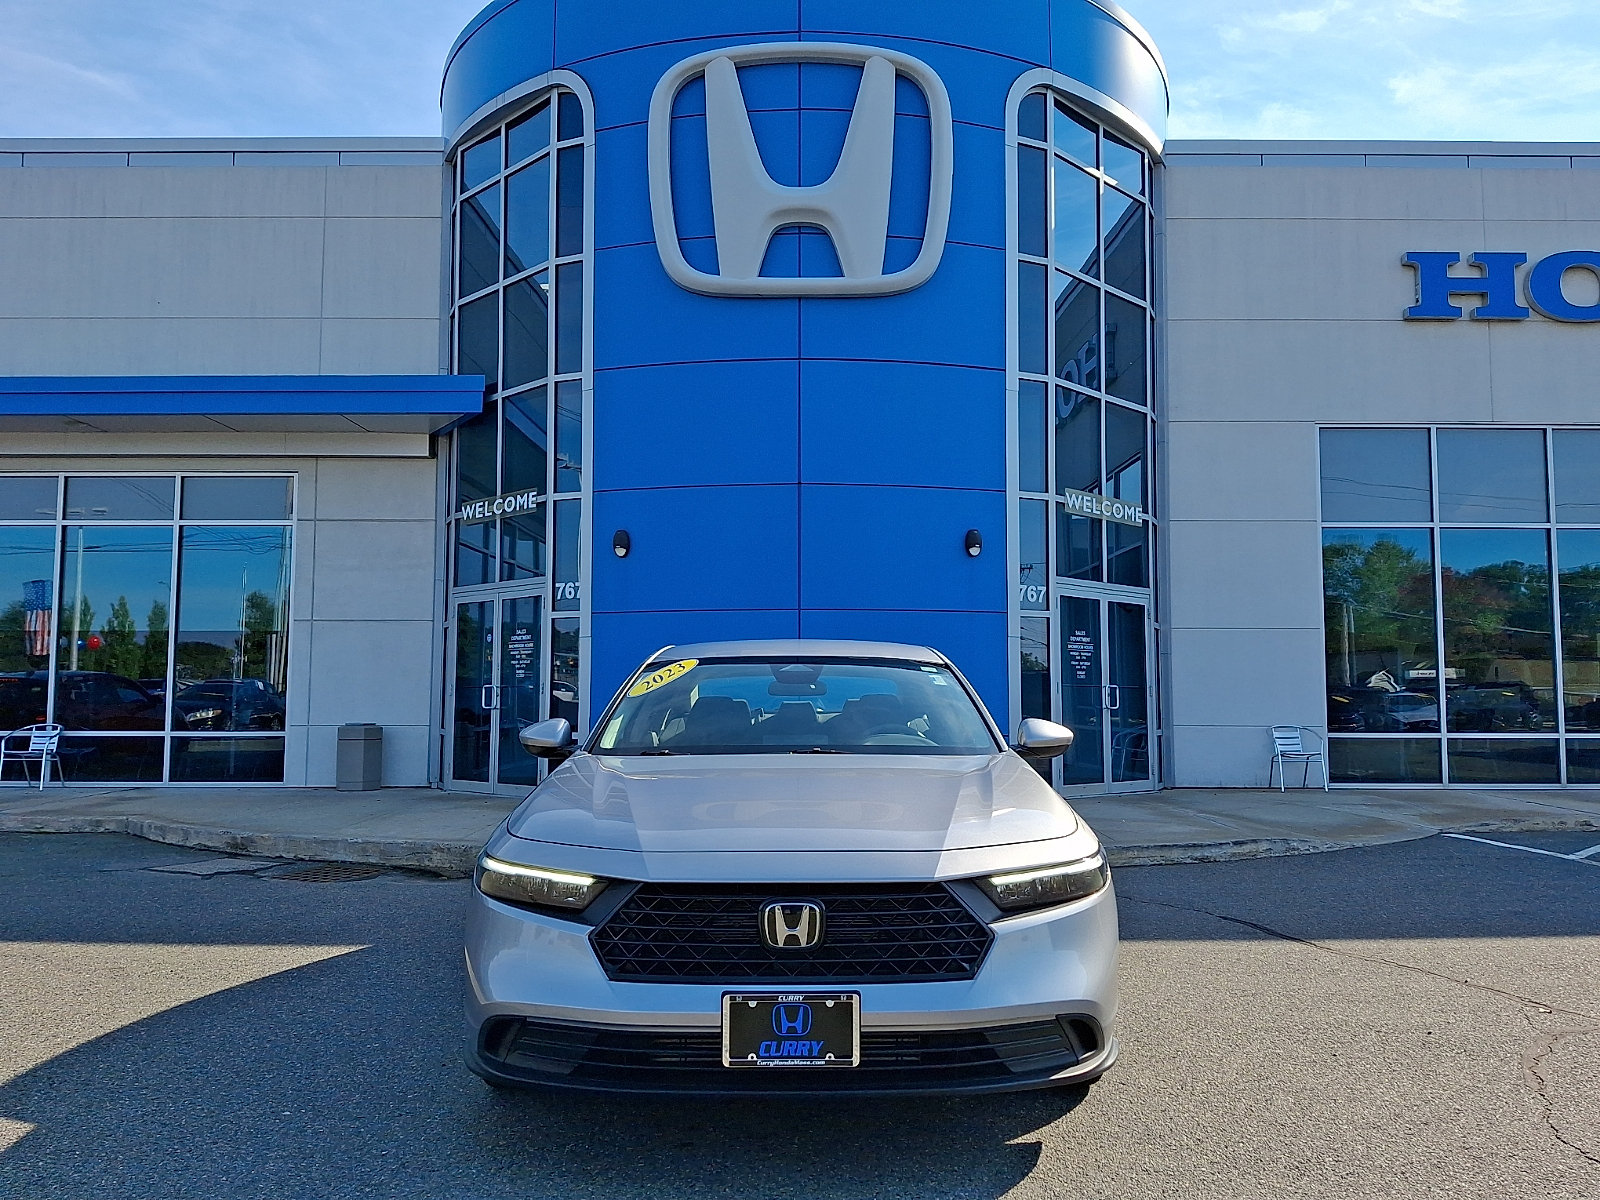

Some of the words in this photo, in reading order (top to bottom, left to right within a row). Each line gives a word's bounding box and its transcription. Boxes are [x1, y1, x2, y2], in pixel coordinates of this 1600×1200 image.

[1401, 250, 1600, 323] HO
[461, 491, 538, 521] WELCOME
[1065, 492, 1142, 523] WELCOME
[1019, 584, 1046, 603] 767
[641, 662, 687, 691] 2023
[759, 1040, 824, 1057] CURRY
